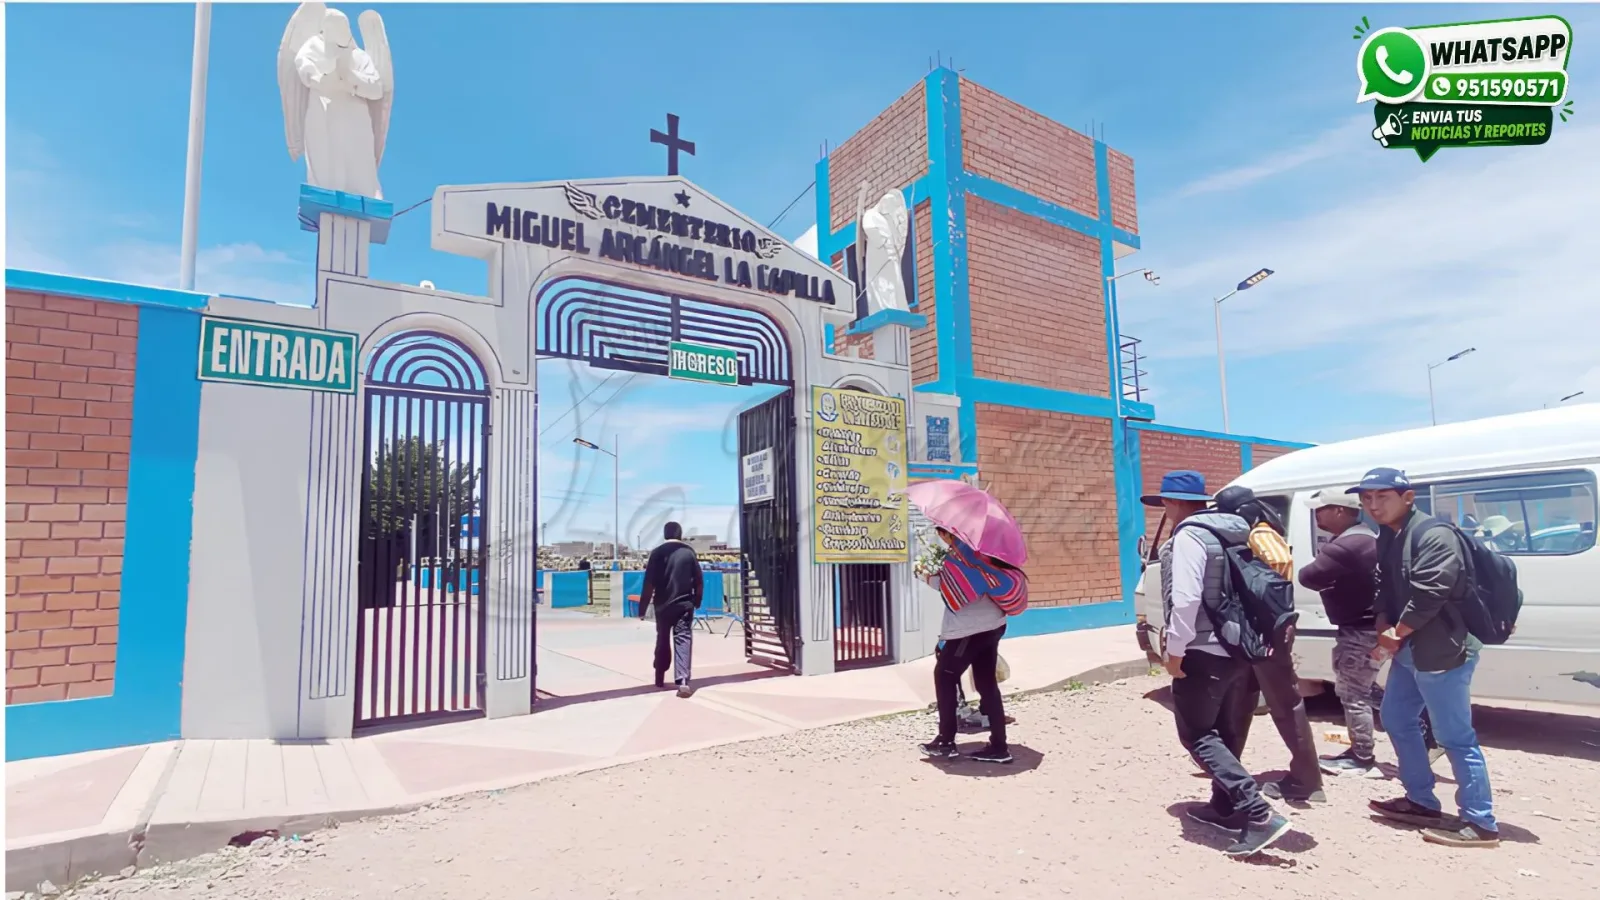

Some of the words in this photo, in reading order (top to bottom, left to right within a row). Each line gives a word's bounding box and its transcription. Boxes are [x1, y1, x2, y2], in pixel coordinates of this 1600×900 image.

[486, 202, 590, 254] MIGUEL
[724, 256, 752, 288] LA
[211, 327, 346, 384] ENTRADA
[672, 349, 735, 376] INGRESO
